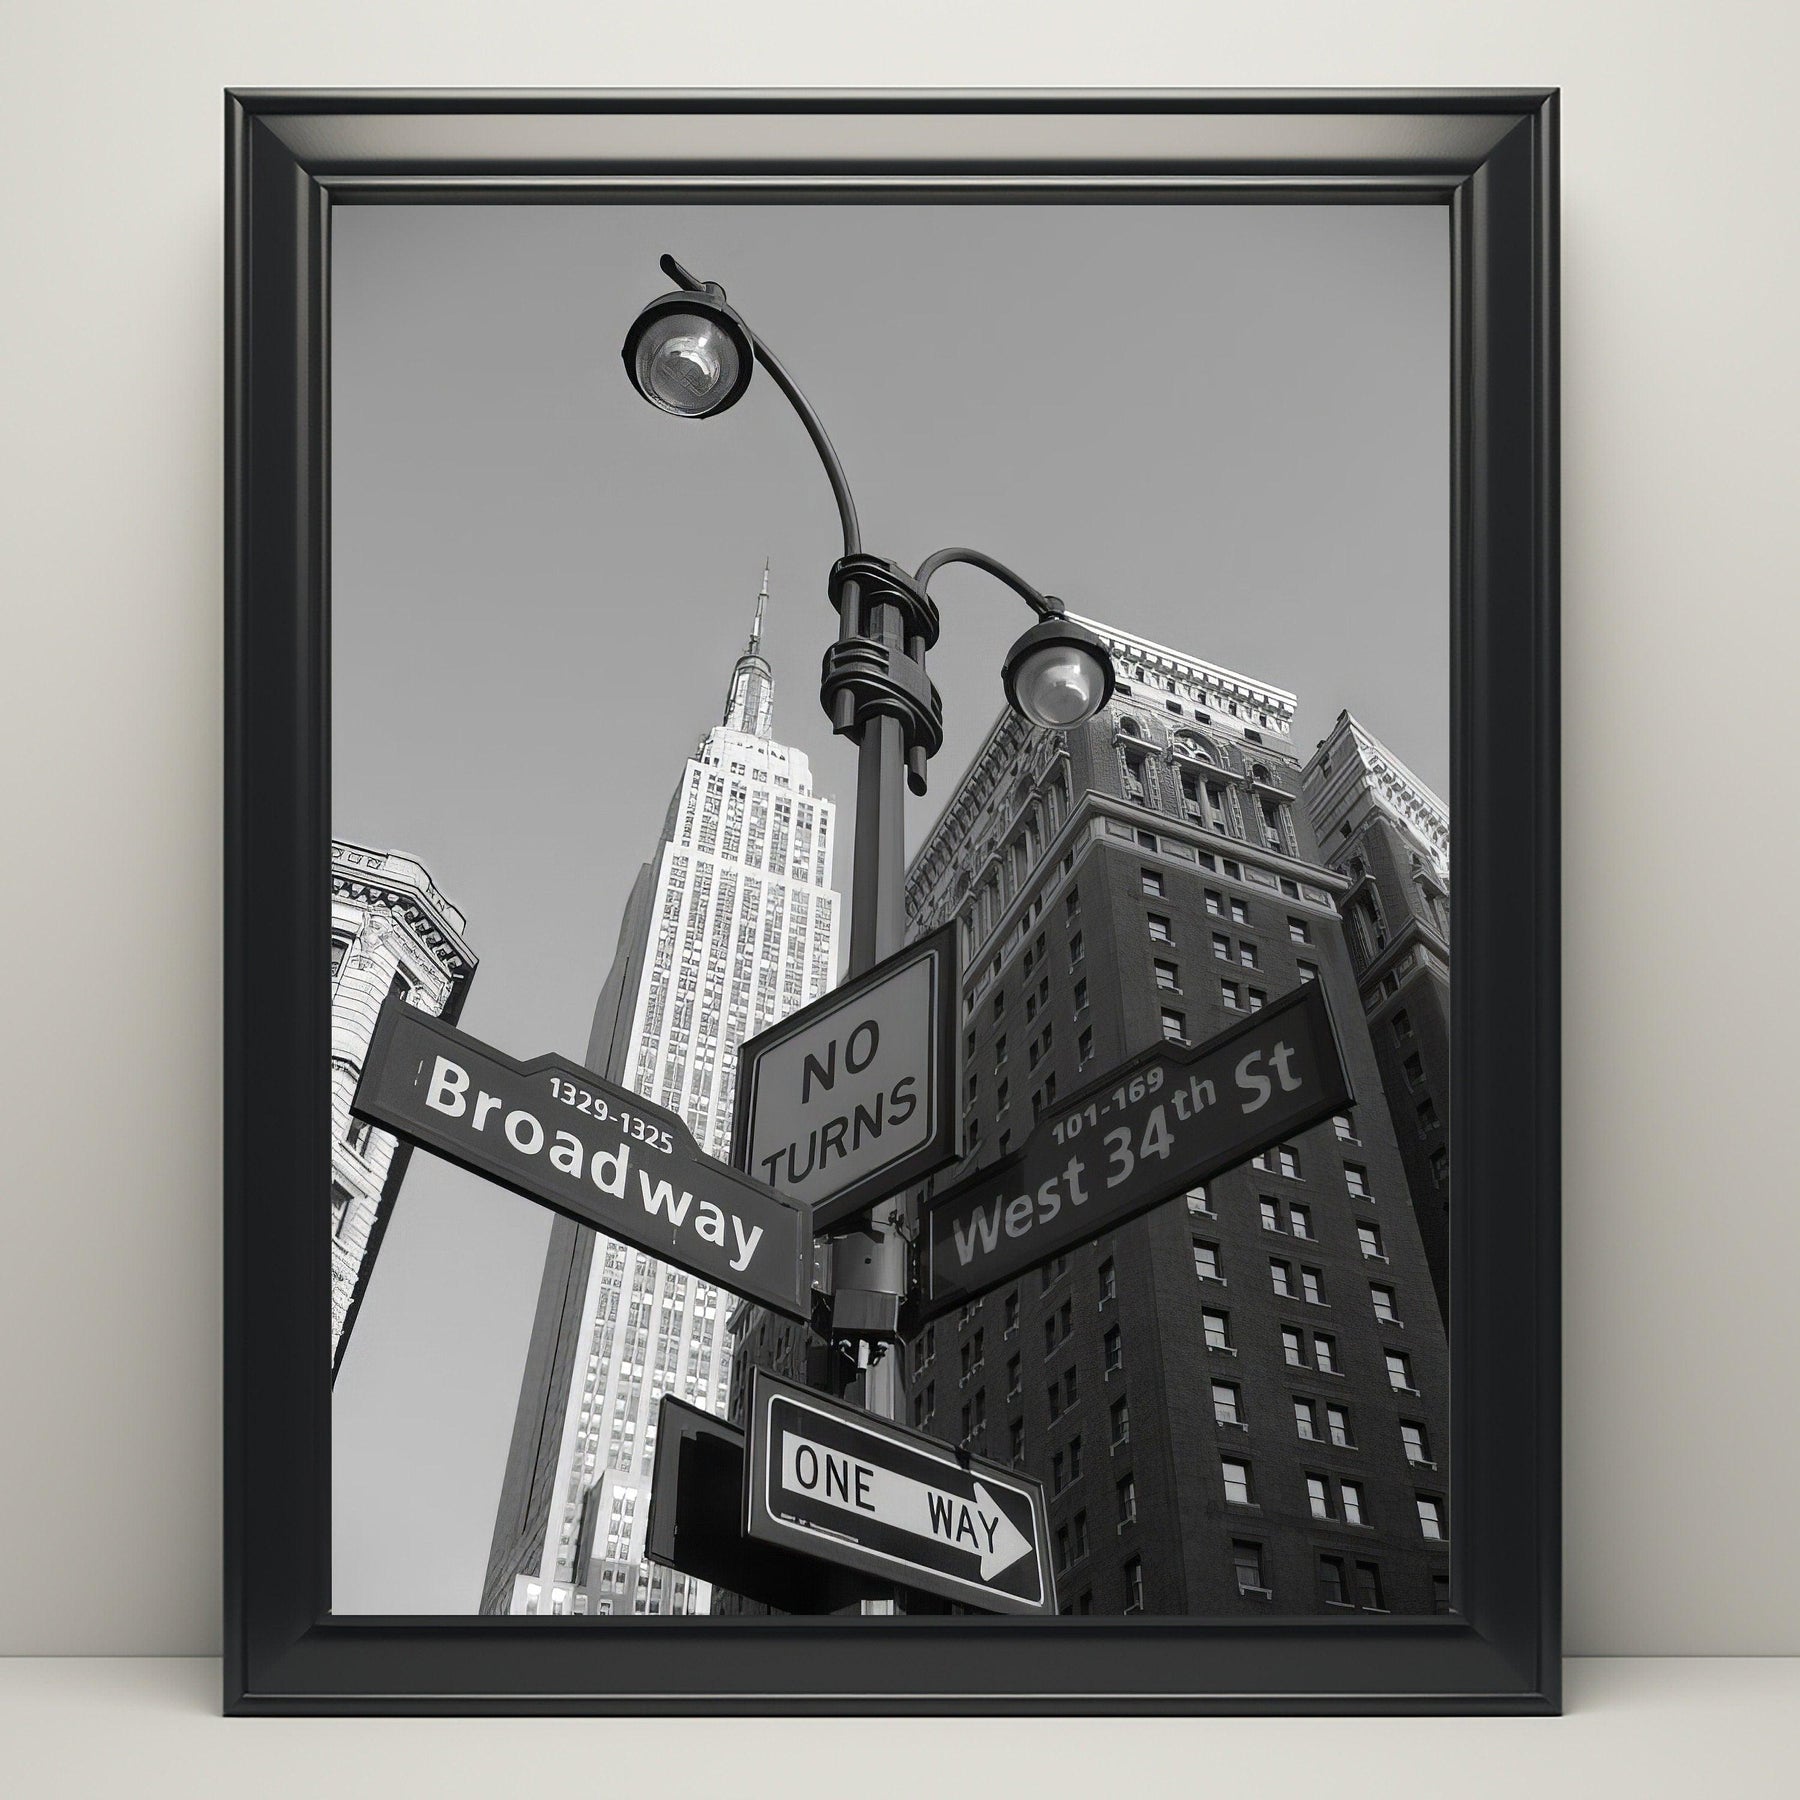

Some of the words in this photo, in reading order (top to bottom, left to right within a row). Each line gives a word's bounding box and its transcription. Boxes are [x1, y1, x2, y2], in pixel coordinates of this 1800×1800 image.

[550, 1077, 674, 1155] 1329-1325
[802, 1019, 880, 1105] NO
[1052, 1066, 1165, 1145] 101-169
[424, 1054, 765, 1273] Broadway
[761, 1076, 918, 1188] TURNS
[953, 1154, 1089, 1267] West
[1103, 1073, 1218, 1189] 34th
[1234, 1039, 1303, 1115] St
[795, 1444, 877, 1513] ONE
[927, 1490, 1000, 1555] WAY
